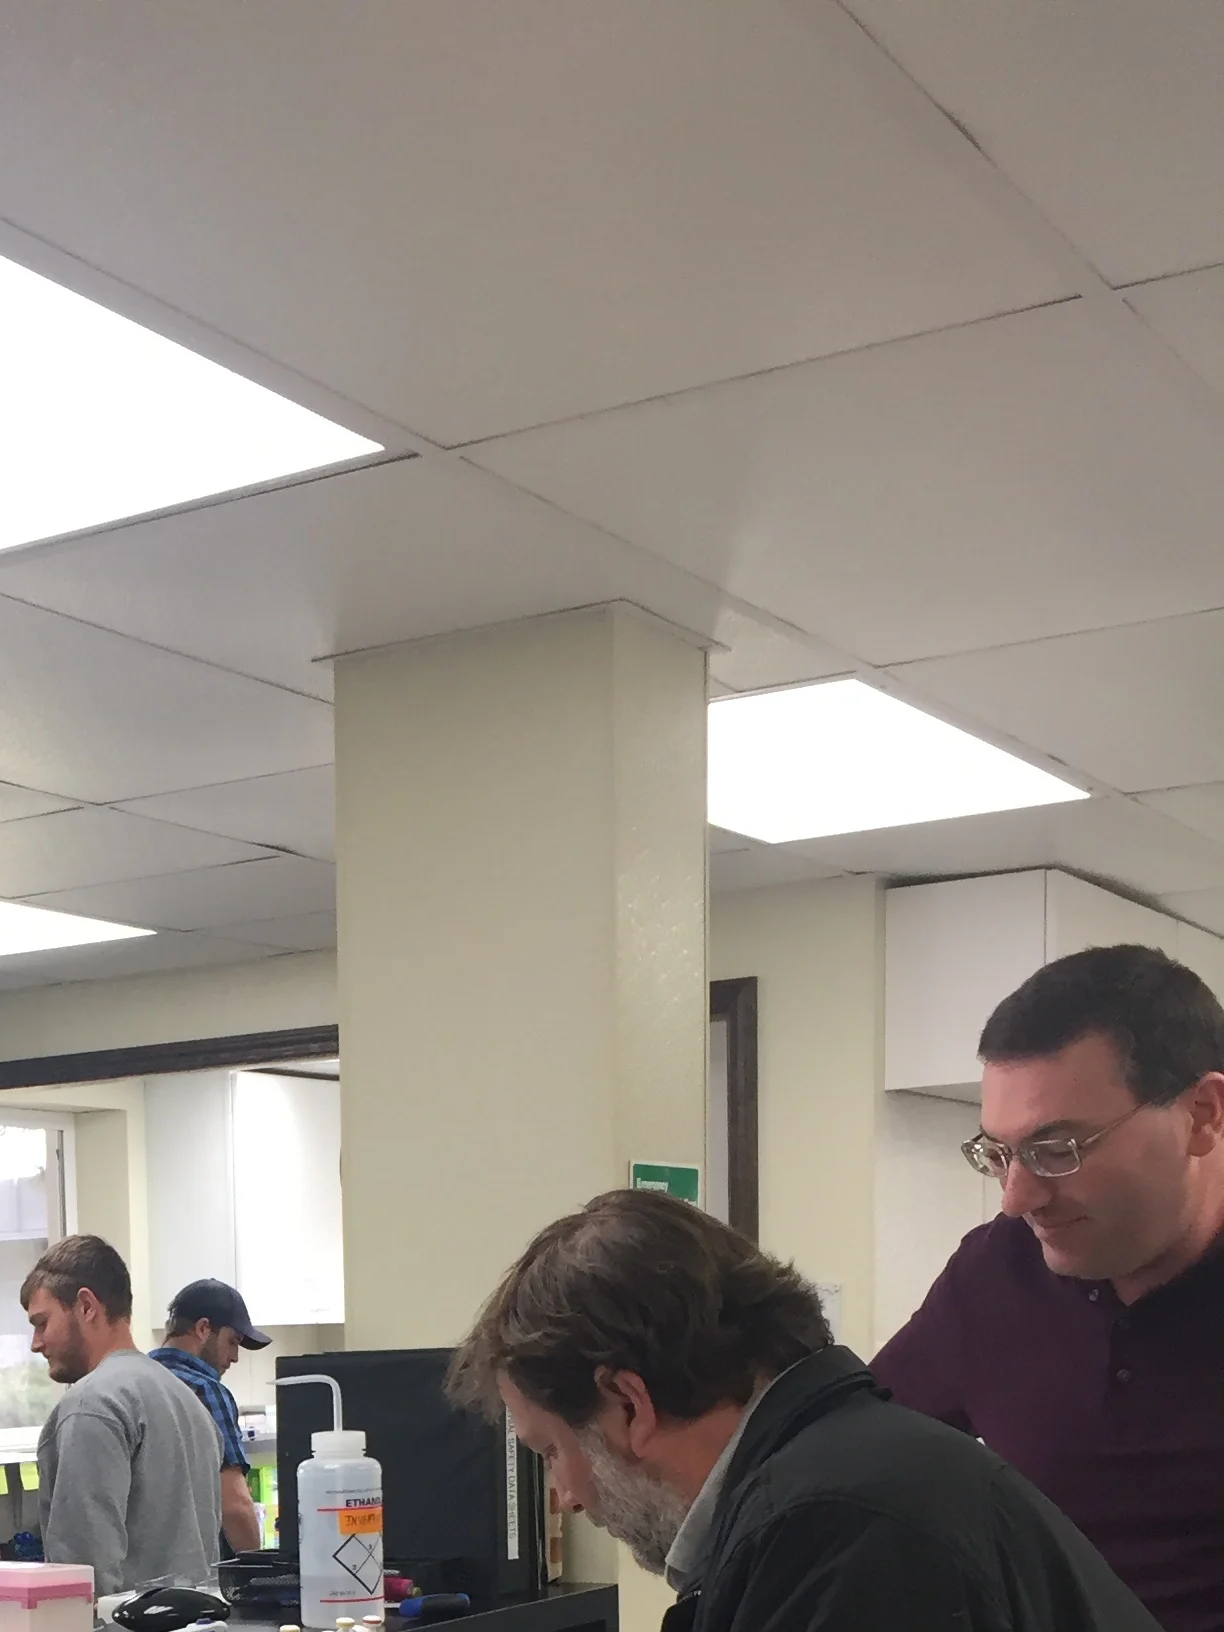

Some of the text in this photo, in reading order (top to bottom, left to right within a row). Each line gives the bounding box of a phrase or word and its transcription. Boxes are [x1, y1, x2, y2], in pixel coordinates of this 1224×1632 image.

[507, 1437, 516, 1473] SAFETY
[507, 1475, 516, 1501] DATA
[508, 1502, 517, 1540] SHEETS
